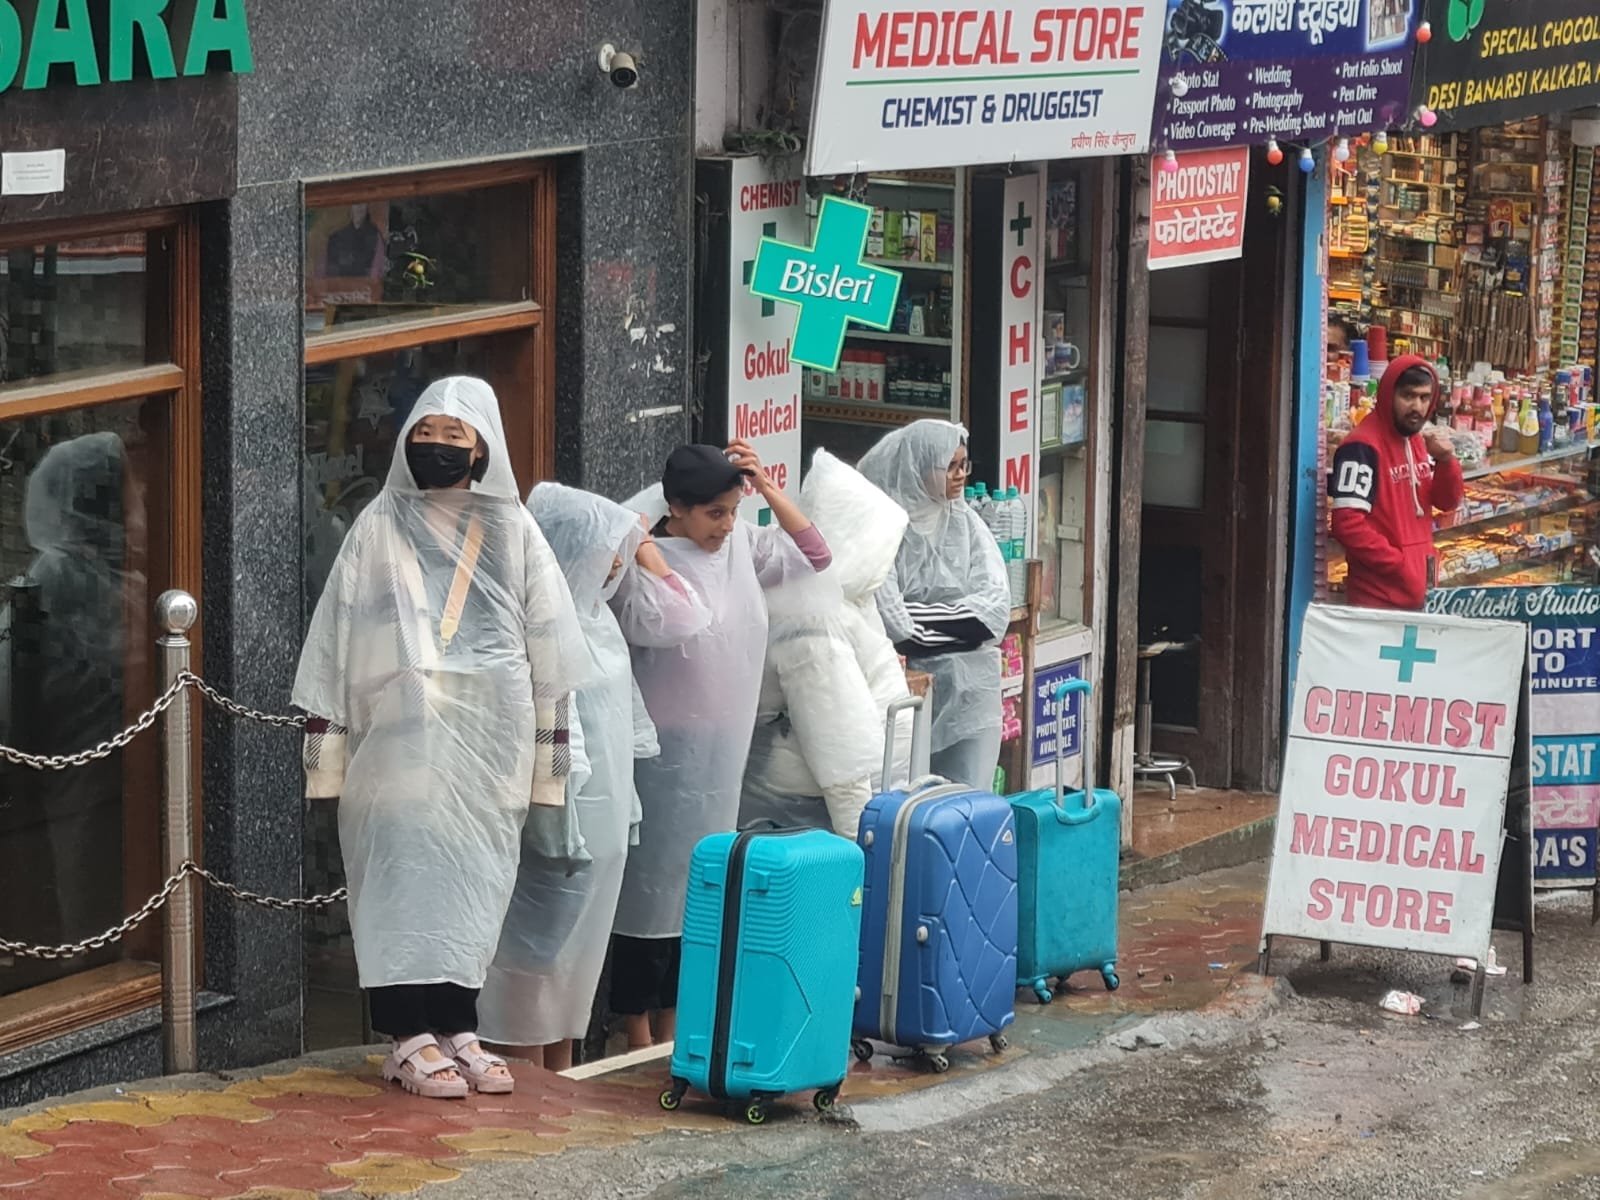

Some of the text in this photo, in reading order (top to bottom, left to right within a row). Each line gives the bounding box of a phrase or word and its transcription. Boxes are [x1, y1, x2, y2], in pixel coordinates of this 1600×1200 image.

[853, 6, 1144, 69] MEDICAL STORE
[1481, 16, 1600, 58] SPECIAL CHOCOL
[1202, 70, 1219, 88] Stat
[1255, 65, 1292, 88] Wedding
[1342, 57, 1403, 78] Port Folio Shoot
[1252, 88, 1303, 113] Photography
[1339, 83, 1377, 102] Pen Drive
[1428, 82, 1461, 111] DESI
[1464, 71, 1528, 105] BANARSI
[1530, 61, 1591, 95] KALKATA
[881, 89, 1103, 128] CHEMIST & DRUGGIST
[1172, 93, 1236, 119] Passport Photo
[1250, 111, 1326, 136] Pre-Wedding Shoot
[1337, 107, 1373, 126] Print Out
[1171, 120, 1236, 141] Video Coverage
[740, 180, 801, 212] CHEMIST
[1157, 162, 1241, 201] PHOTOSTAT
[1154, 204, 1238, 245] फोटोस्टेट
[778, 258, 876, 304] Bisleri
[744, 338, 790, 380] Gokul
[735, 394, 797, 438] Medical
[744, 463, 787, 497] Sre
[1337, 461, 1374, 498] 03
[1425, 586, 1600, 617] Kailash Studio
[1036, 714, 1076, 739] PHOTOTATE
[1304, 686, 1507, 751] CHEMIST
[1040, 734, 1072, 755] AVAILLE
[1324, 754, 1466, 808] GOKUL
[1289, 812, 1485, 874] MEDICAL
[1306, 877, 1454, 934] STORE
